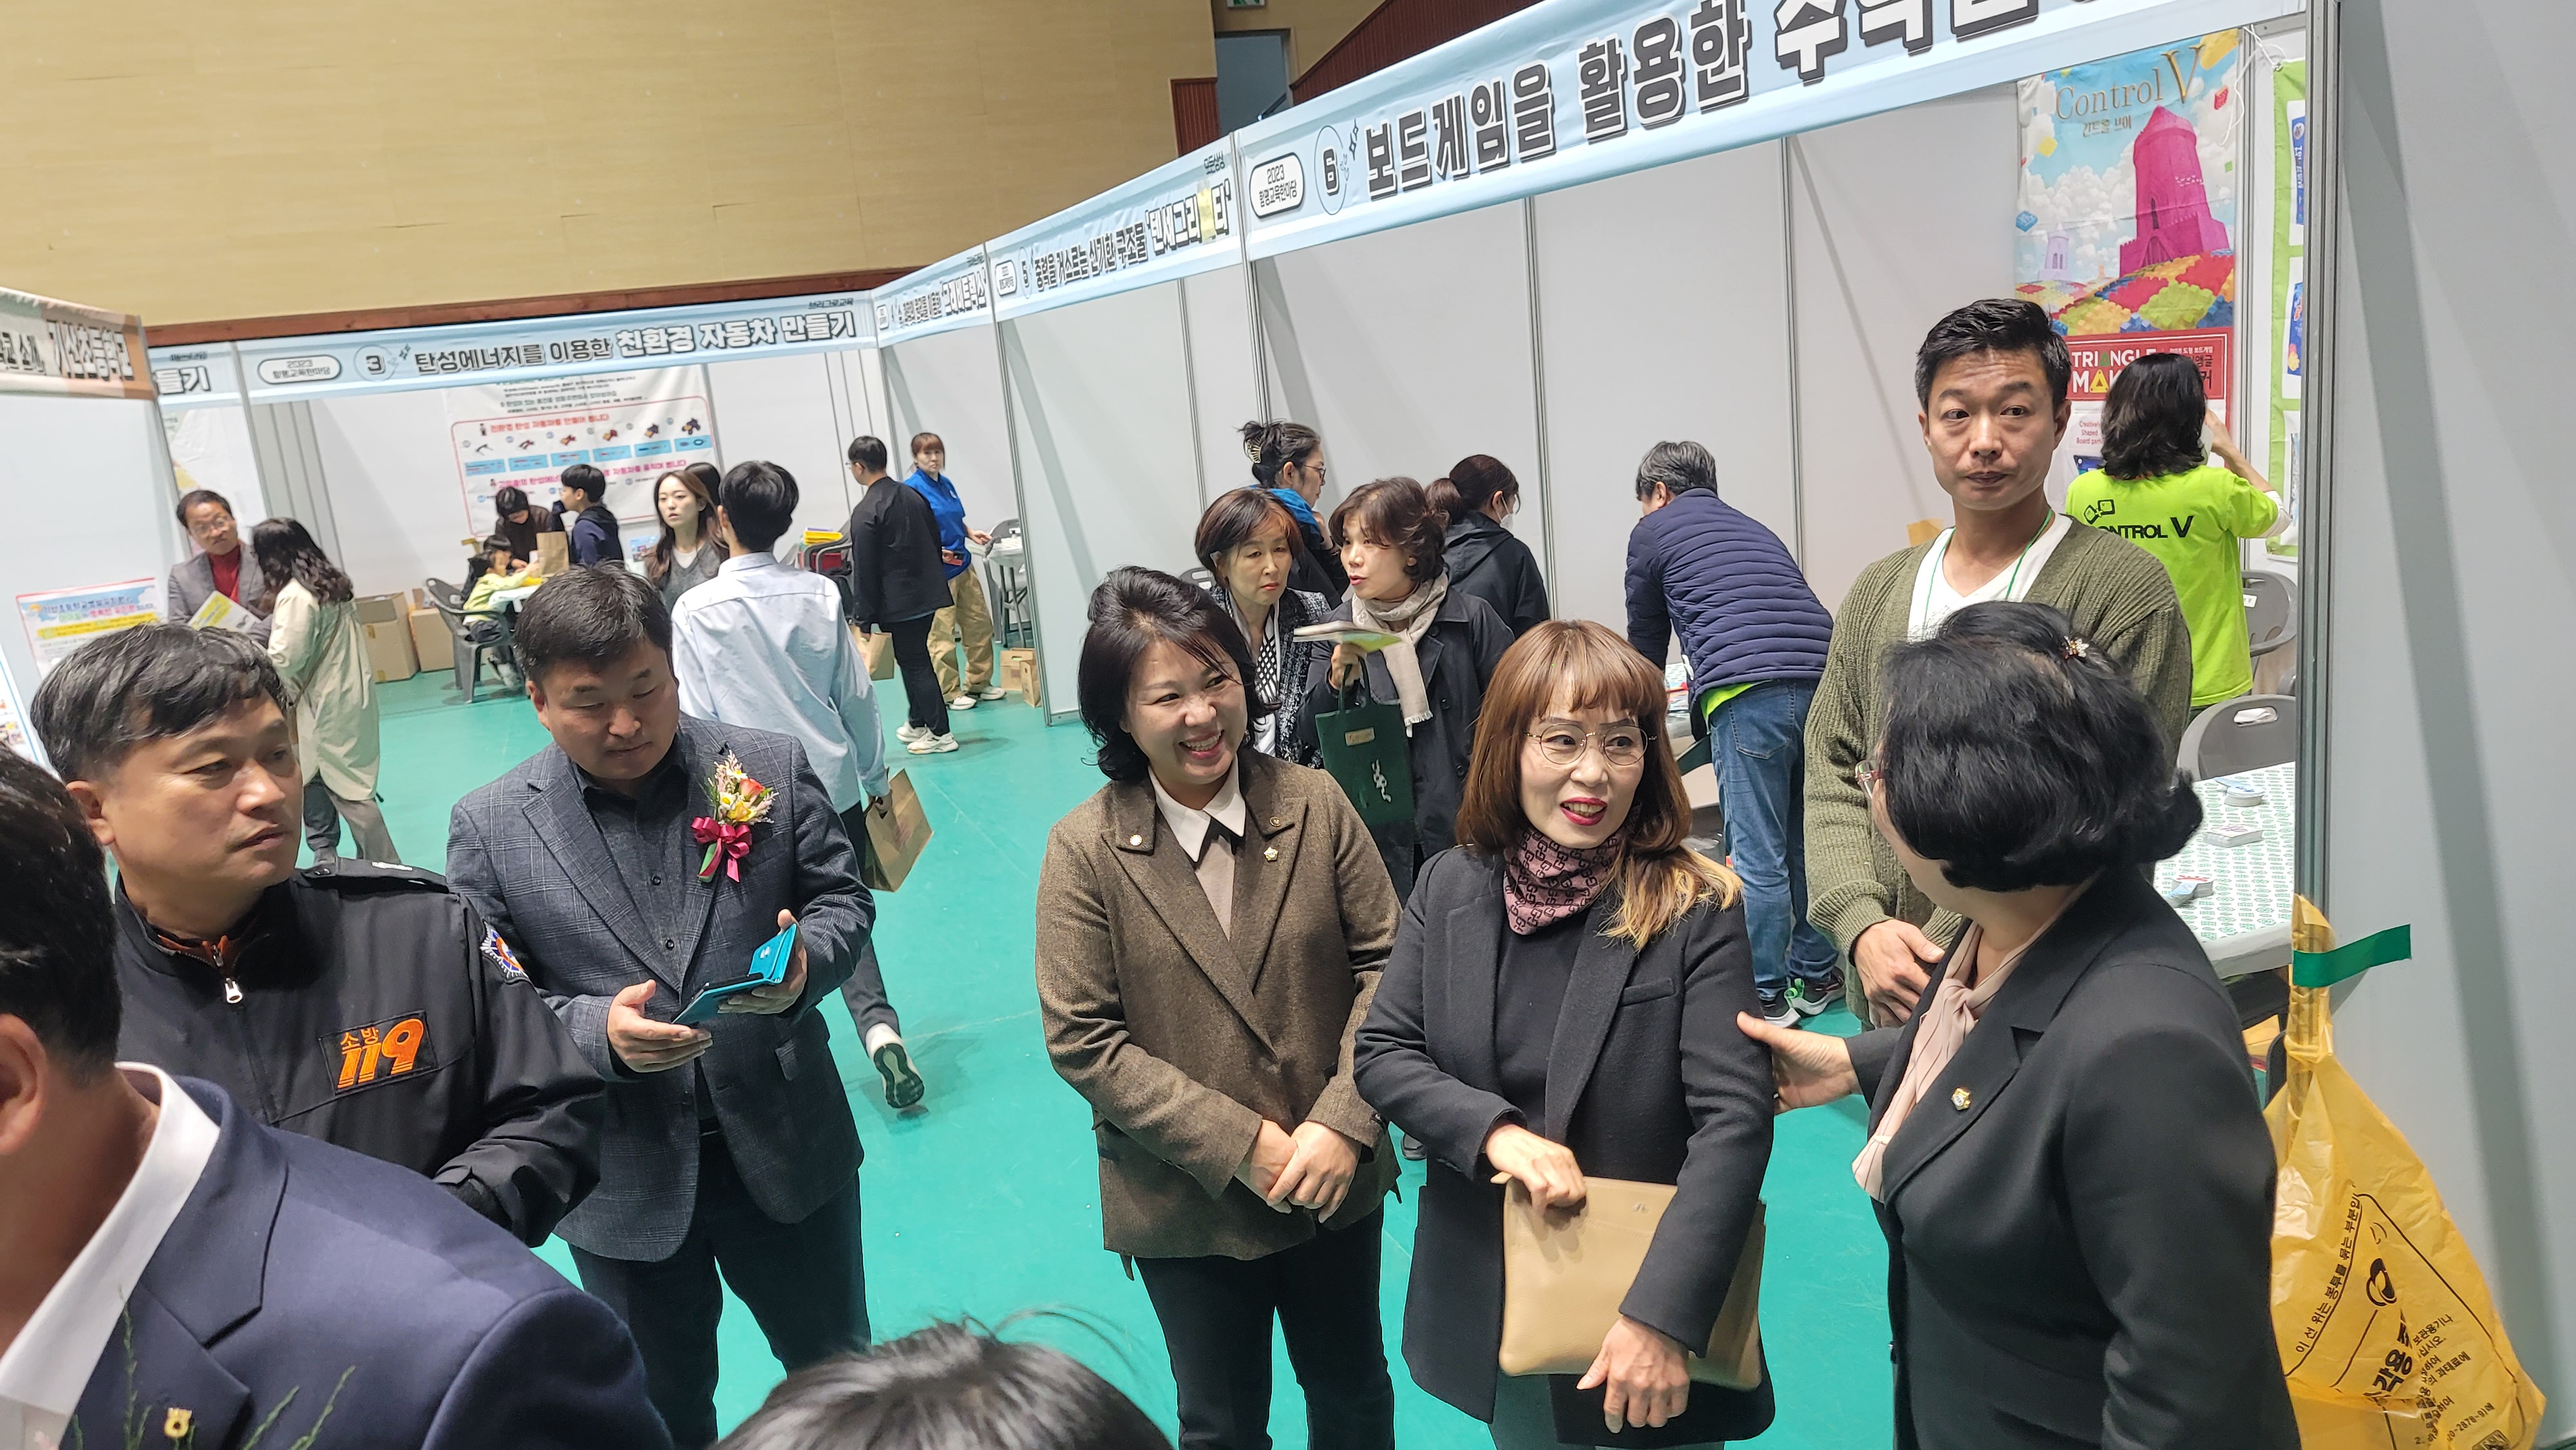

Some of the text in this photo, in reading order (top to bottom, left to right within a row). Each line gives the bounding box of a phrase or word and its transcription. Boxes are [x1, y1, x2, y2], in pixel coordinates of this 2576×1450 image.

[1365, 61, 1557, 200] 보드게임을
[1577, 0, 1751, 144] 활용한
[2056, 44, 2205, 119] Control V
[1267, 164, 1285, 184] 2023
[1323, 148, 1340, 196] 6
[1034, 254, 1057, 292] 중력을
[1056, 245, 1090, 285] 거스르는
[1090, 232, 1117, 277] 신기한
[1115, 221, 1148, 268] 구조물
[1145, 178, 1231, 256] '텐세그리티'
[415, 343, 546, 375] 탄성에너지를
[550, 338, 613, 362] 이용한
[616, 325, 696, 358] 친환경
[699, 318, 777, 350] 자동차
[780, 311, 857, 343] 만들기
[2072, 348, 2156, 368] TRIANG
[155, 366, 211, 395] 들기
[366, 354, 384, 375] 3
[2170, 515, 2194, 538] V
[337, 1018, 424, 1089] 119
[340, 1027, 379, 1050] 소방
[2295, 1341, 2310, 1353] 이
[2304, 1326, 2318, 1340] 선
[2311, 1302, 2331, 1324] 위는
[2325, 1263, 2347, 1299] 봉투를
[2344, 1196, 2361, 1233] 부분입
[2418, 1335, 2447, 1357] 십시오.
[2437, 1351, 2472, 1378] 과태료에
[2363, 1350, 2412, 1397] 각용
